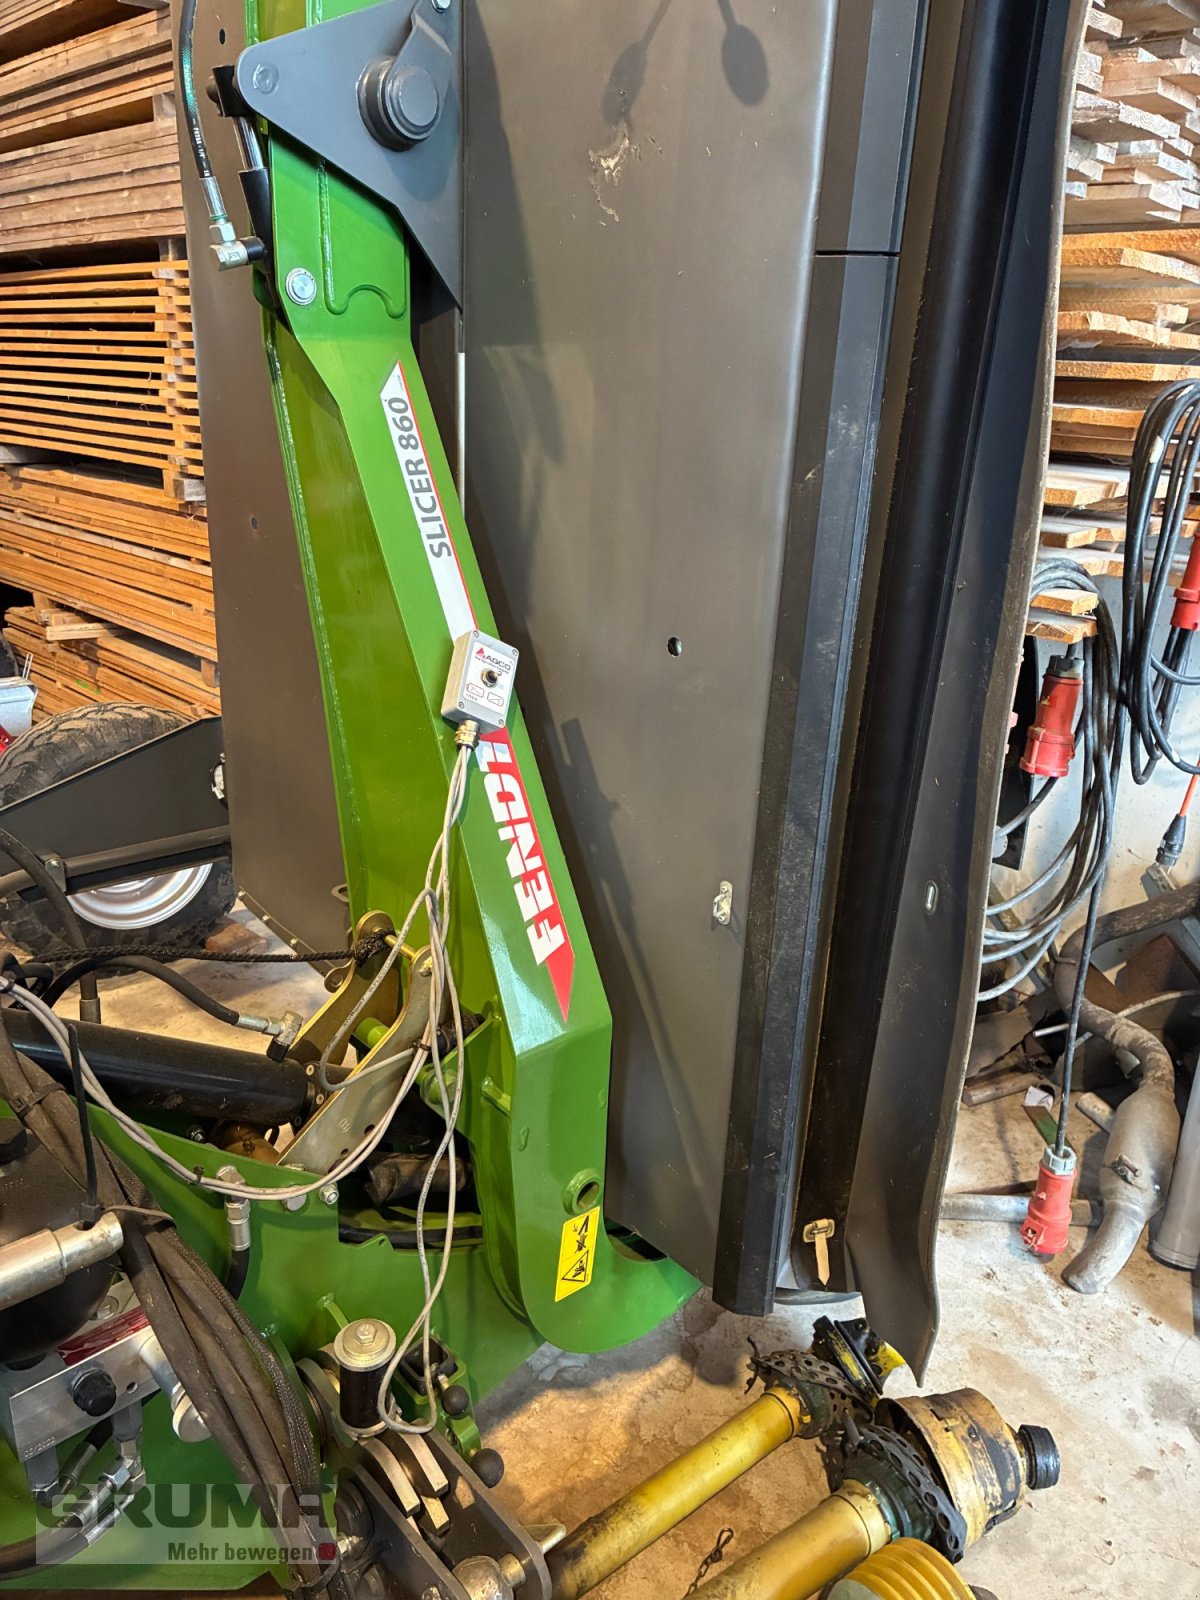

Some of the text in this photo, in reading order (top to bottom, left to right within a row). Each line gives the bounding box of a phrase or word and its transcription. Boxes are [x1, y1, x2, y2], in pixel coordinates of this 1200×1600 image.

[388, 397, 452, 558] SLICER 860
[486, 655, 511, 671] AGCO
[475, 741, 566, 966] FENDT
